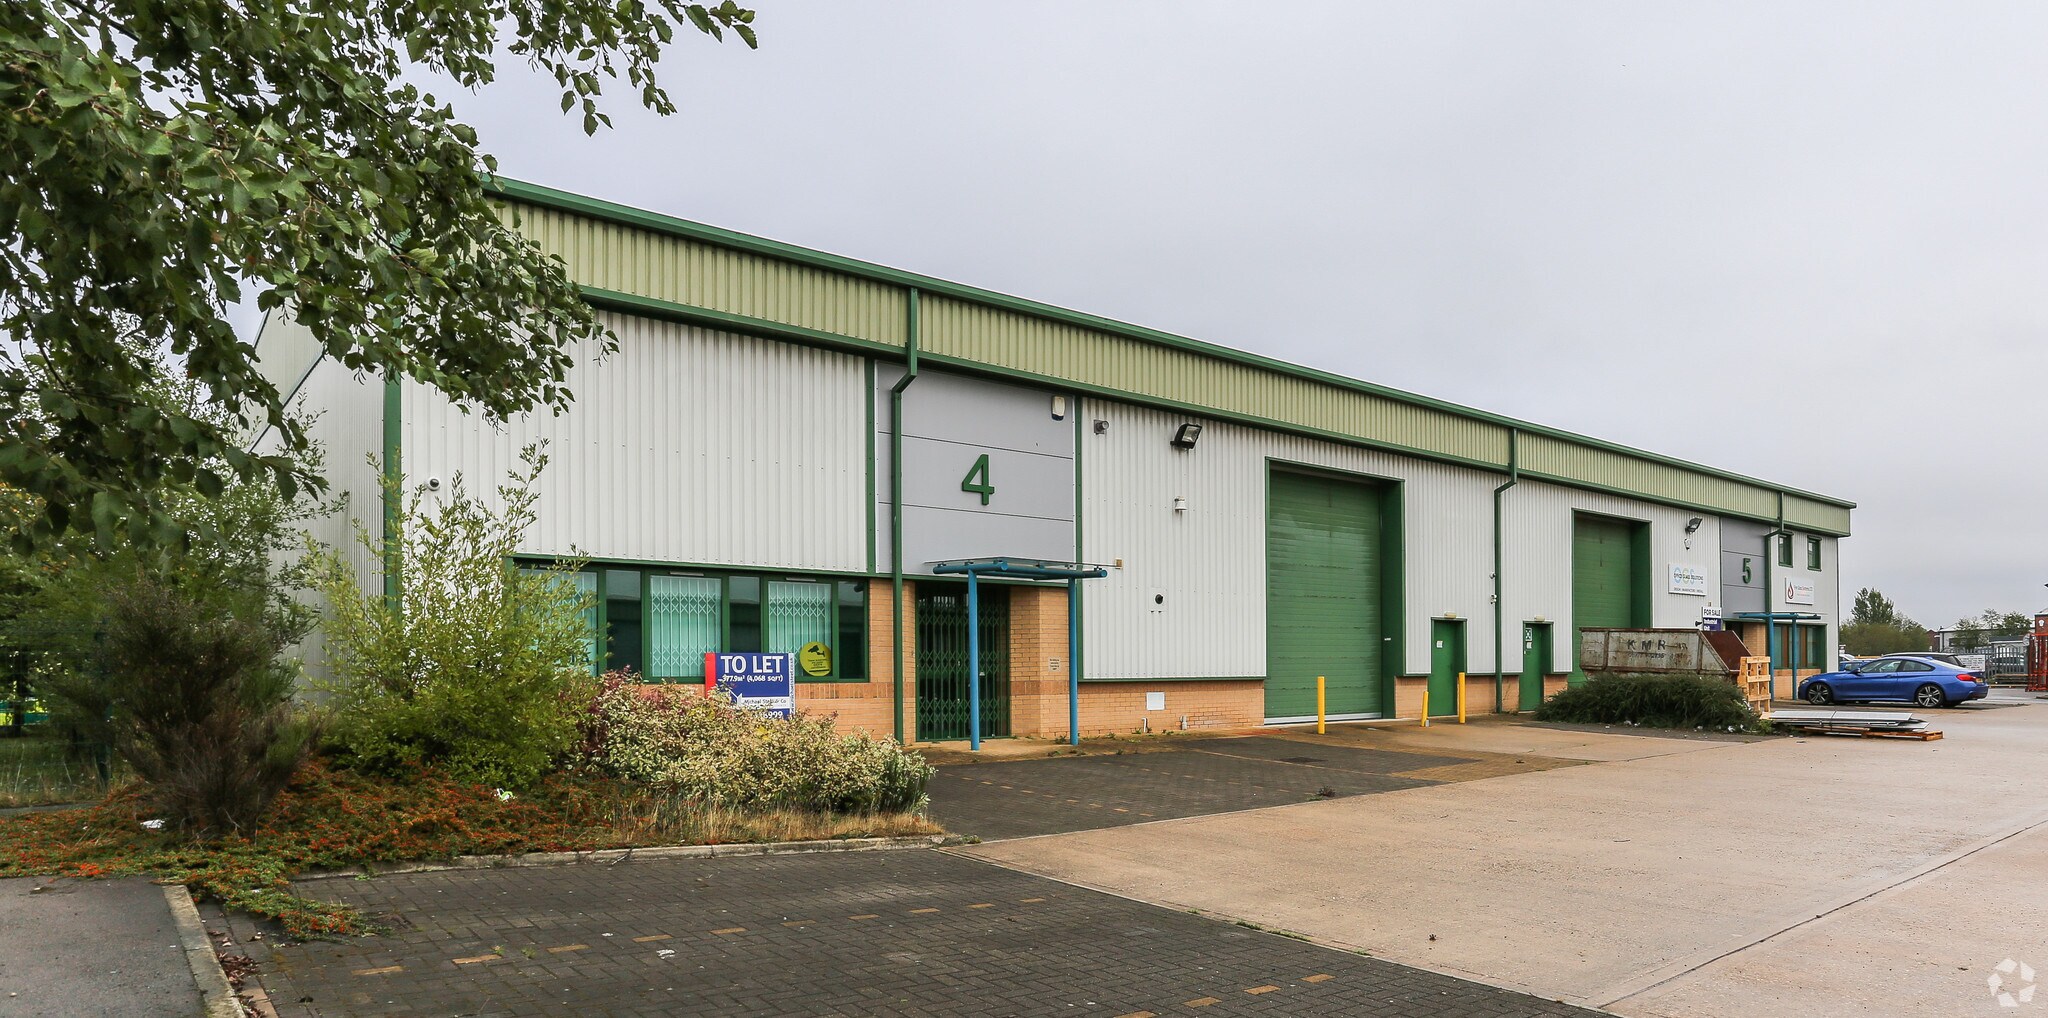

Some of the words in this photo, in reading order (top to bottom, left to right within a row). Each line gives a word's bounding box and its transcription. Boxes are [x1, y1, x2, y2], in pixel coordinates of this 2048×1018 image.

[961, 453, 995, 506] 4
[1742, 557, 1752, 584] 5
[1703, 608, 1711, 616] FOR
[1711, 609, 1721, 617] SALE
[720, 655, 747, 674] TO
[752, 655, 784, 674] LET
